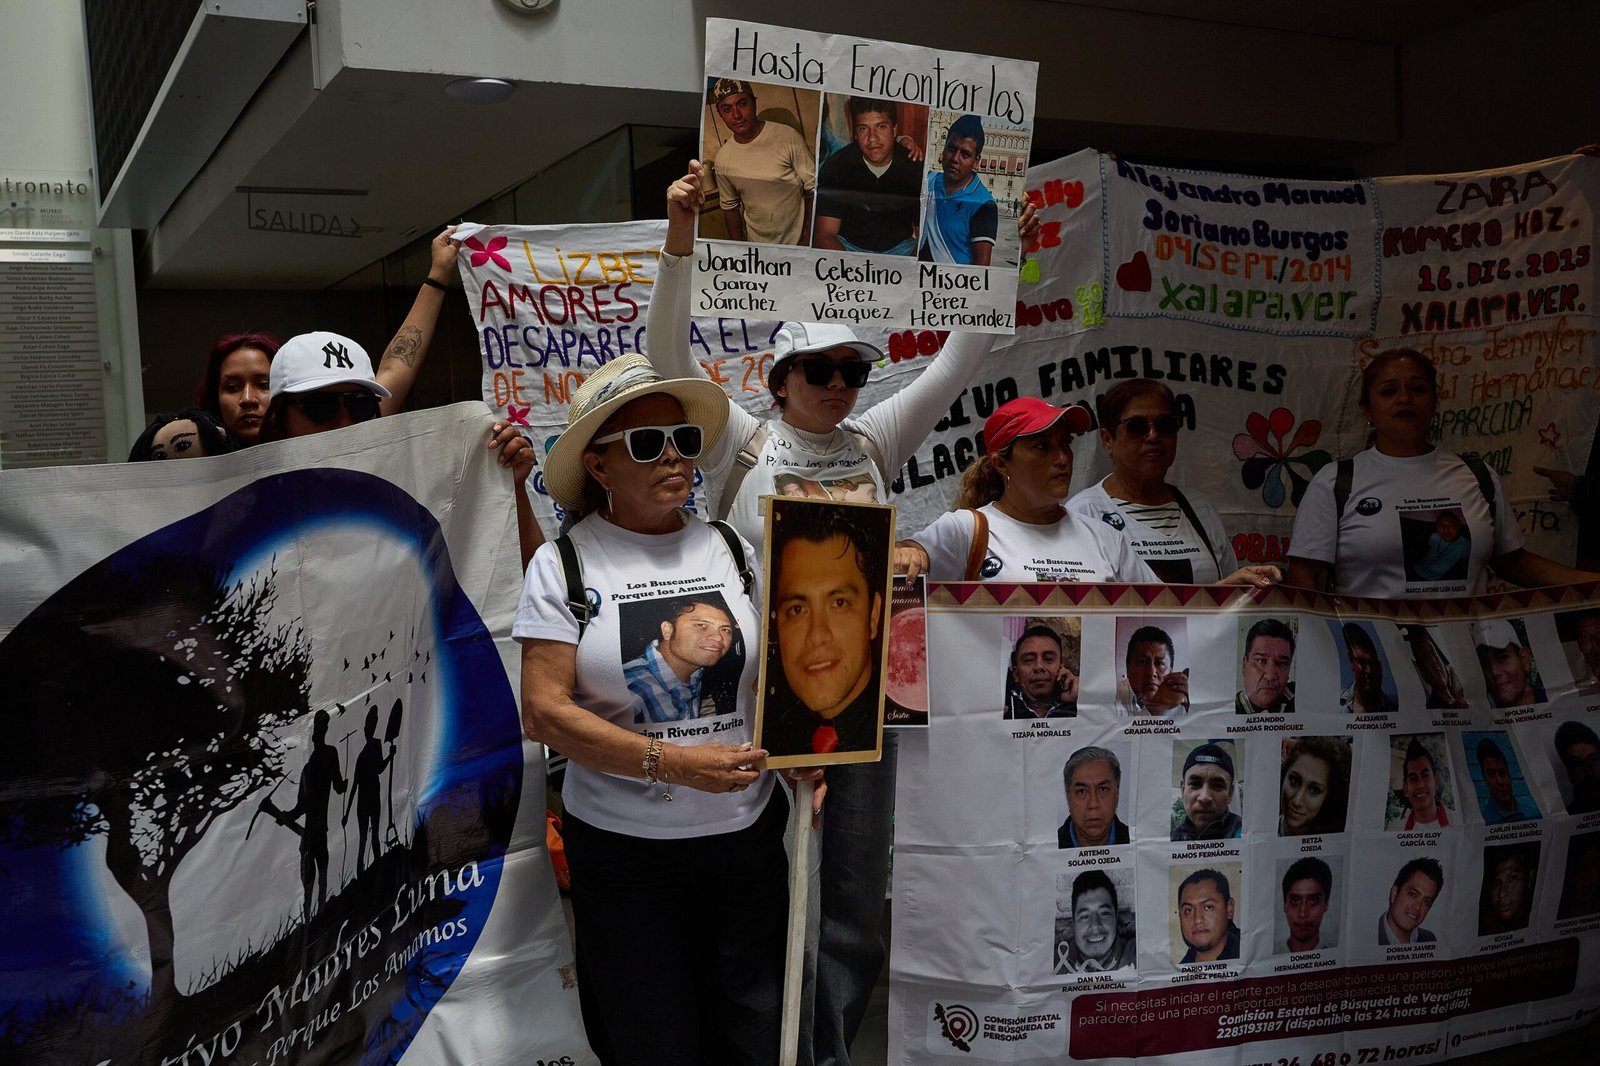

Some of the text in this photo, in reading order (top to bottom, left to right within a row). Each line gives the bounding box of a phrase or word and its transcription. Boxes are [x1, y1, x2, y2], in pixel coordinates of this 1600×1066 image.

[732, 27, 824, 85] Hasta
[1263, 183, 1366, 206] Manuel
[1435, 171, 1558, 214] ZARA
[255, 209, 344, 235] SALIDA
[1252, 220, 1349, 261] Burgos
[1383, 219, 1503, 257] ROMERO
[698, 244, 791, 277] Jonathan
[815, 258, 902, 285] Celestino
[920, 264, 989, 290] Misael
[714, 274, 769, 293] Garay
[827, 282, 877, 303] Pérez
[480, 279, 639, 325] AMORES
[700, 288, 778, 312] Sánchez
[922, 291, 969, 309] Pérez
[812, 302, 894, 323] Vázquez
[911, 308, 1014, 327] Hernandez
[322, 341, 354, 369] NY
[1038, 345, 1287, 398] FAMILIARES
[493, 370, 530, 407] DE
[1141, 539, 1184, 547] Buscamos
[1164, 546, 1200, 555] Amamos
[1046, 558, 1083, 566] Buscamos
[1023, 565, 1050, 573] Porque
[1064, 567, 1096, 575] Amamos
[626, 576, 707, 590] Los Buscamos
[611, 582, 726, 602] Porque los Amamos
[1030, 721, 1051, 729] ABEL
[1132, 719, 1175, 727] ALEJANDRO
[1226, 722, 1304, 732] BARRADAS RODRÍGUEZ
[1246, 716, 1286, 724] ALEJANDRO
[1346, 722, 1379, 730] FIGUEROA
[667, 726, 710, 739] Rivera
[712, 717, 744, 733] Zurita
[1012, 729, 1072, 739] TIZAPA MORALES
[1124, 726, 1181, 735] GRANJA GARCÍA
[1397, 831, 1442, 840] CARLOS ELOY
[1186, 842, 1225, 851] BERNARDO
[1400, 839, 1426, 847] GARCÍA
[1078, 848, 1110, 858] ARTEMIO
[1172, 848, 1240, 860] RAMOS FERNÁNDEZ
[1068, 856, 1121, 867] SOLANO OJEDA
[256, 860, 485, 1033] Madres Luna
[1386, 944, 1436, 955] DORIAN JAVIER
[1290, 953, 1321, 962] DOMINGO
[1386, 950, 1434, 962] RIVERA ZURITA
[346, 980, 379, 1014] Los
[385, 916, 468, 982] Amamos
[1203, 963, 1228, 972] JAVIER
[1274, 959, 1337, 973] HERNÁNDEZ RAMOS
[1077, 974, 1114, 984] DAN YAEL
[1171, 970, 1239, 983] GUTIÉRREZ PERALTA
[1062, 982, 1127, 993] RANGEL MARCIAL
[1095, 1000, 1107, 1012] Si
[1111, 997, 1167, 1011] necesitas
[1170, 990, 1204, 1006] iniciar
[1208, 990, 1218, 1001] el
[1221, 985, 1262, 1001] reporte
[1265, 983, 1285, 998] por
[1287, 981, 1297, 993] la
[1370, 972, 1387, 983] de
[1387, 970, 1409, 981] una
[1412, 967, 1457, 984] persona
[1079, 1014, 1138, 1028] paradero
[1140, 1011, 1155, 1023] de
[1157, 1008, 1180, 1020] una
[1183, 1002, 1231, 1018] persona
[1234, 995, 1288, 1012] reportada
[1291, 992, 1323, 1005] como
[1218, 987, 1473, 1026] Comisión Estatal de Búsqueda de Veracruz:
[984, 1013, 1062, 1025] COMISIÓN ESTATAL
[1216, 1020, 1283, 1040] 2283193187
[1285, 1013, 1351, 1032] (disponible
[1354, 1010, 1372, 1023] las
[1374, 1009, 1390, 1021] 24
[1393, 1006, 1428, 1019] horas
[1430, 1002, 1448, 1015] del
[984, 1022, 1056, 1034] DE BÚSQUEDA DE
[983, 1031, 1028, 1042] PERSONAS
[1340, 1053, 1352, 1065] o
[1357, 1048, 1380, 1064] 72
[1383, 1038, 1442, 1061] horas!
